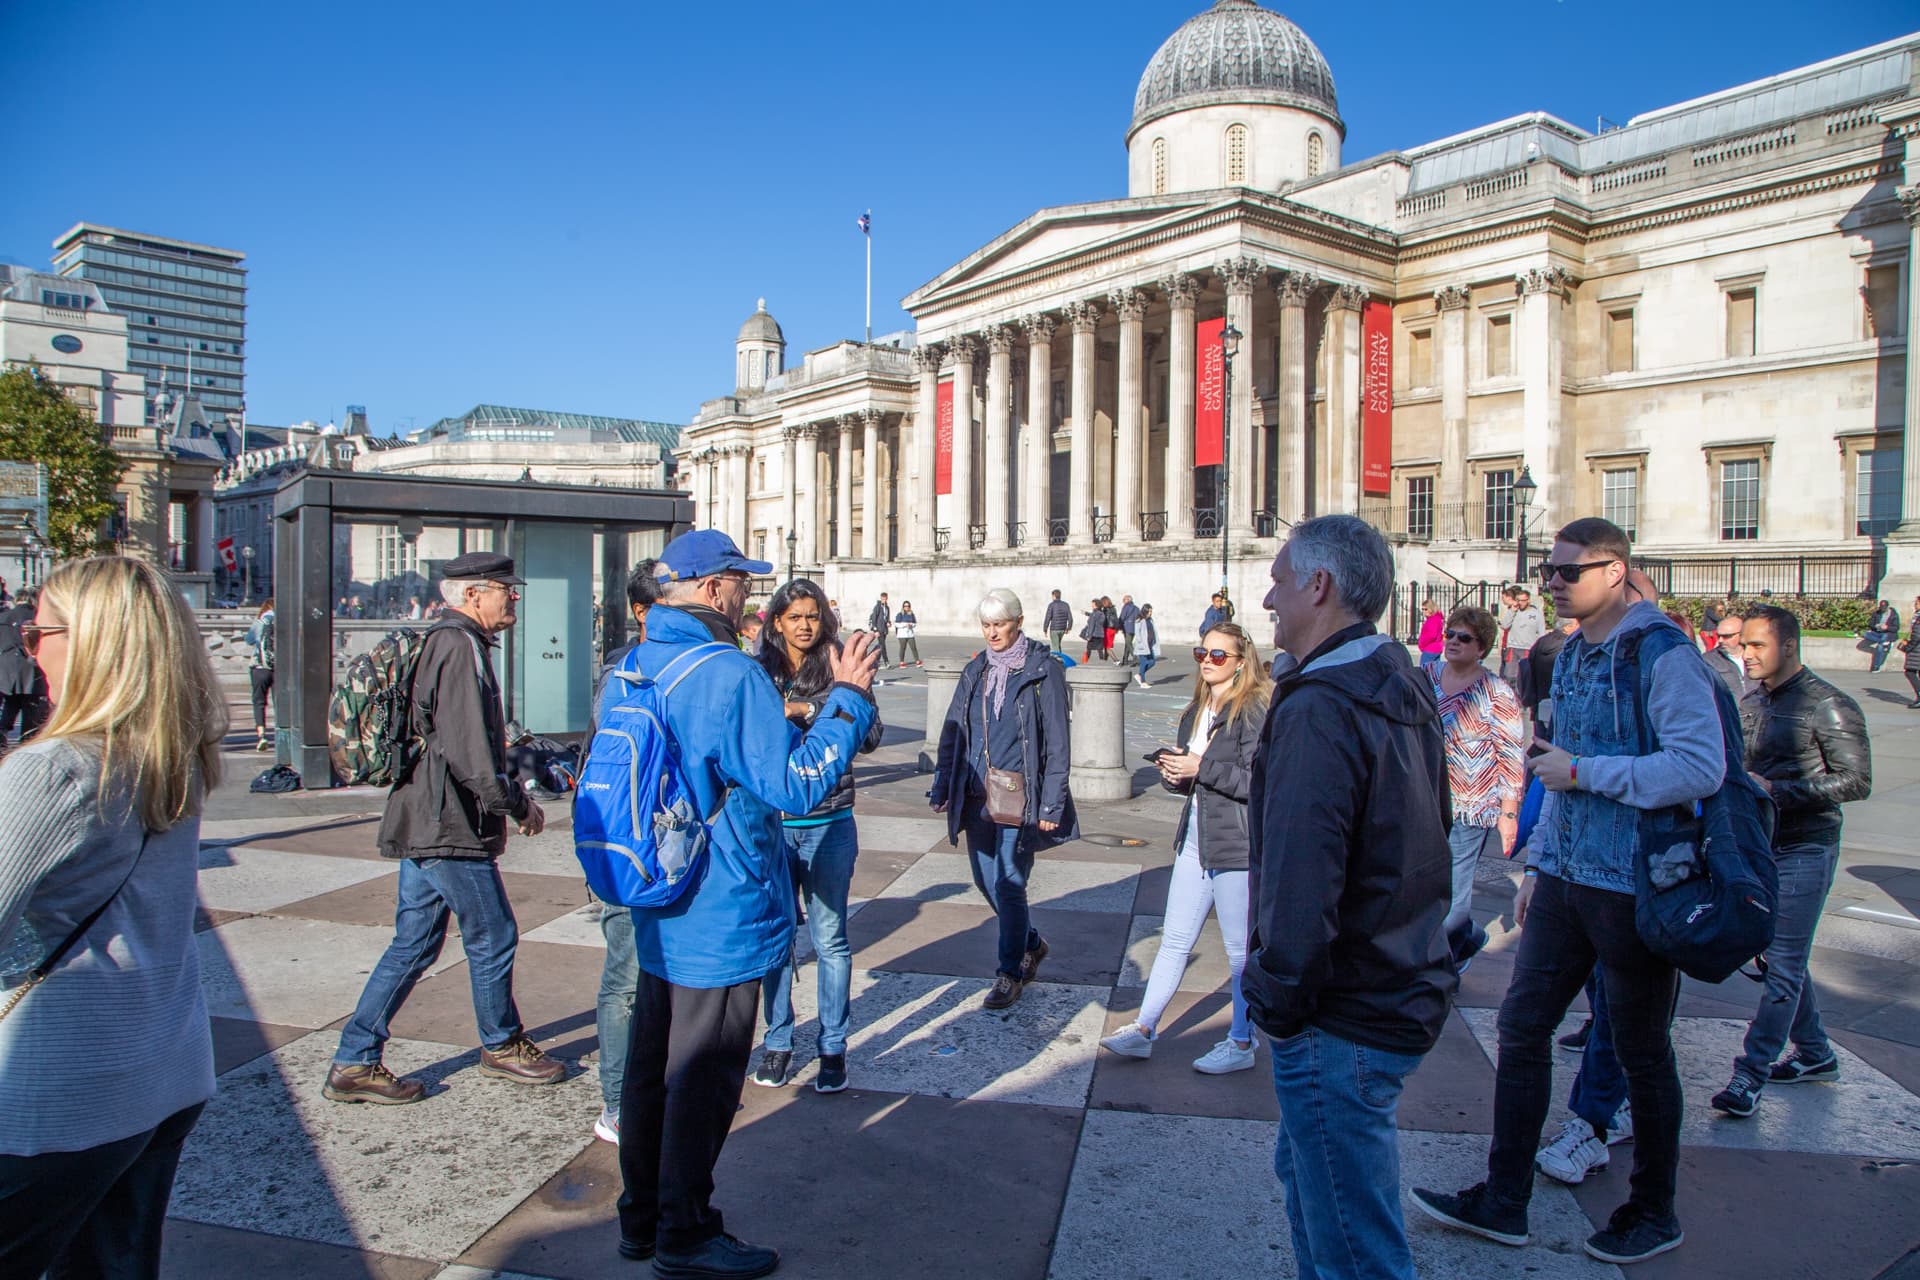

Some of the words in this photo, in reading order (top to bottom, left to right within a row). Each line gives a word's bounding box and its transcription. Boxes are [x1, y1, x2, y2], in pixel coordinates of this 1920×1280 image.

[1204, 344, 1212, 411] NATIONAL
[1212, 344, 1221, 410] GALLERY
[1370, 330, 1379, 412] NATIONAL
[1378, 331, 1388, 413] GALLERY
